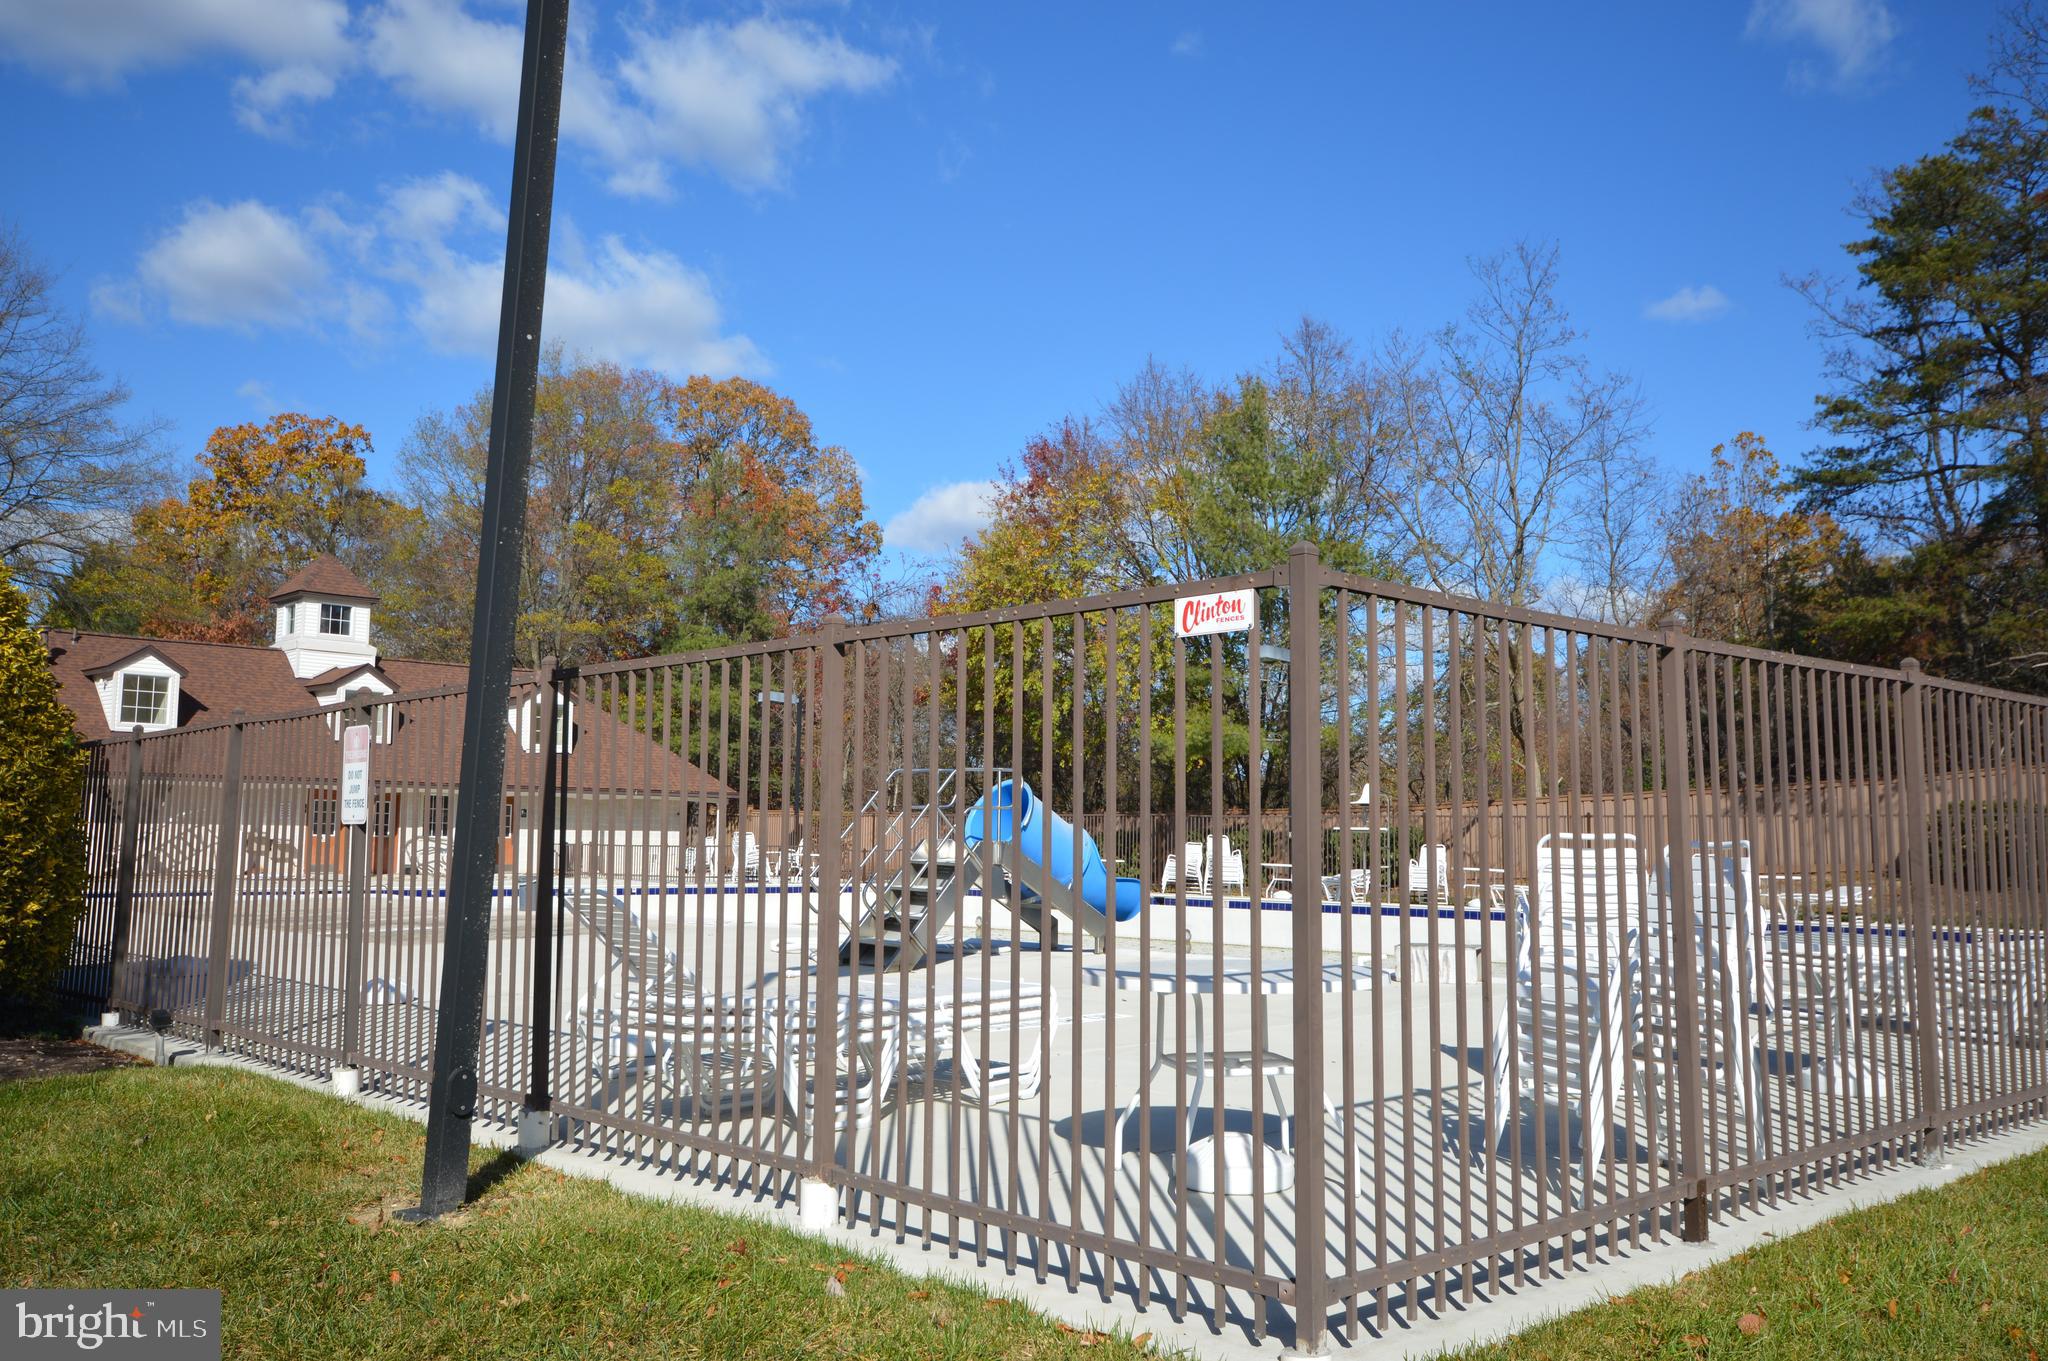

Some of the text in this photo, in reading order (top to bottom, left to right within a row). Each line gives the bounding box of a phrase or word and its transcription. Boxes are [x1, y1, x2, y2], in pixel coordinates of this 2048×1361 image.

[1182, 595, 1246, 633] Clinton
[1216, 615, 1245, 623] FENCES
[348, 770, 354, 780] DO
[344, 798, 365, 808] THE FENCE
